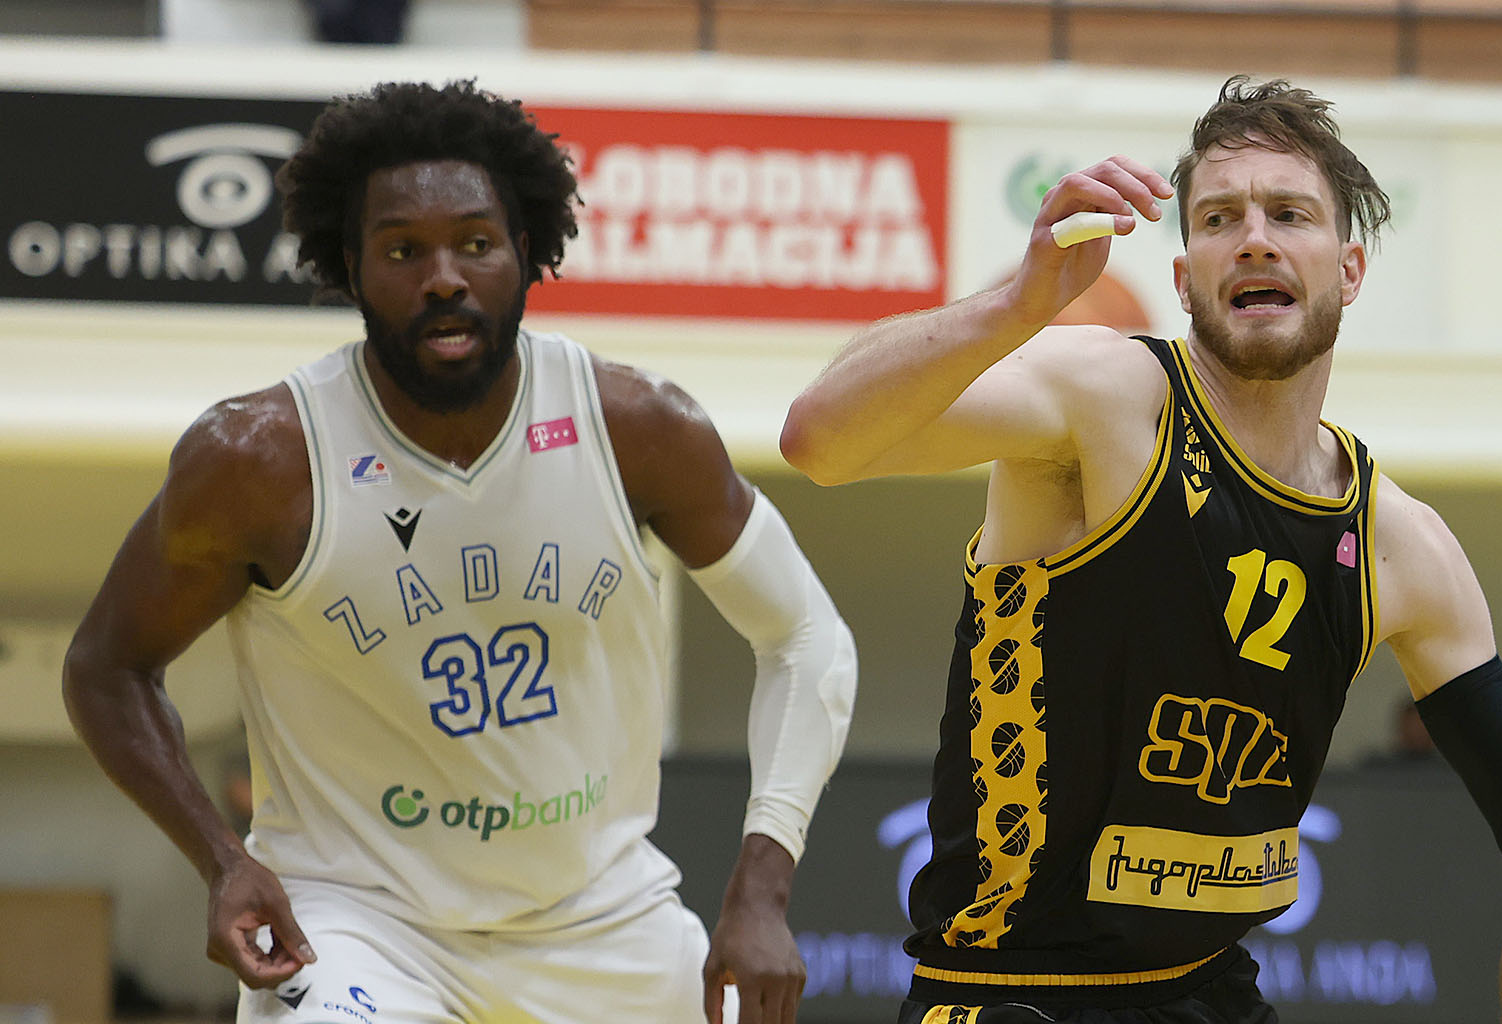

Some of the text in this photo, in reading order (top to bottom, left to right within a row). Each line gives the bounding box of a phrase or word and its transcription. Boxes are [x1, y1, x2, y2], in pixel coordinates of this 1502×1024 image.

[560, 143, 923, 218] LOBODNA
[9, 221, 248, 283] OPTIKA
[558, 219, 939, 292] ALMACIJA
[324, 544, 622, 654] ZADAR
[1223, 548, 1307, 671] 12
[421, 622, 558, 738] 32
